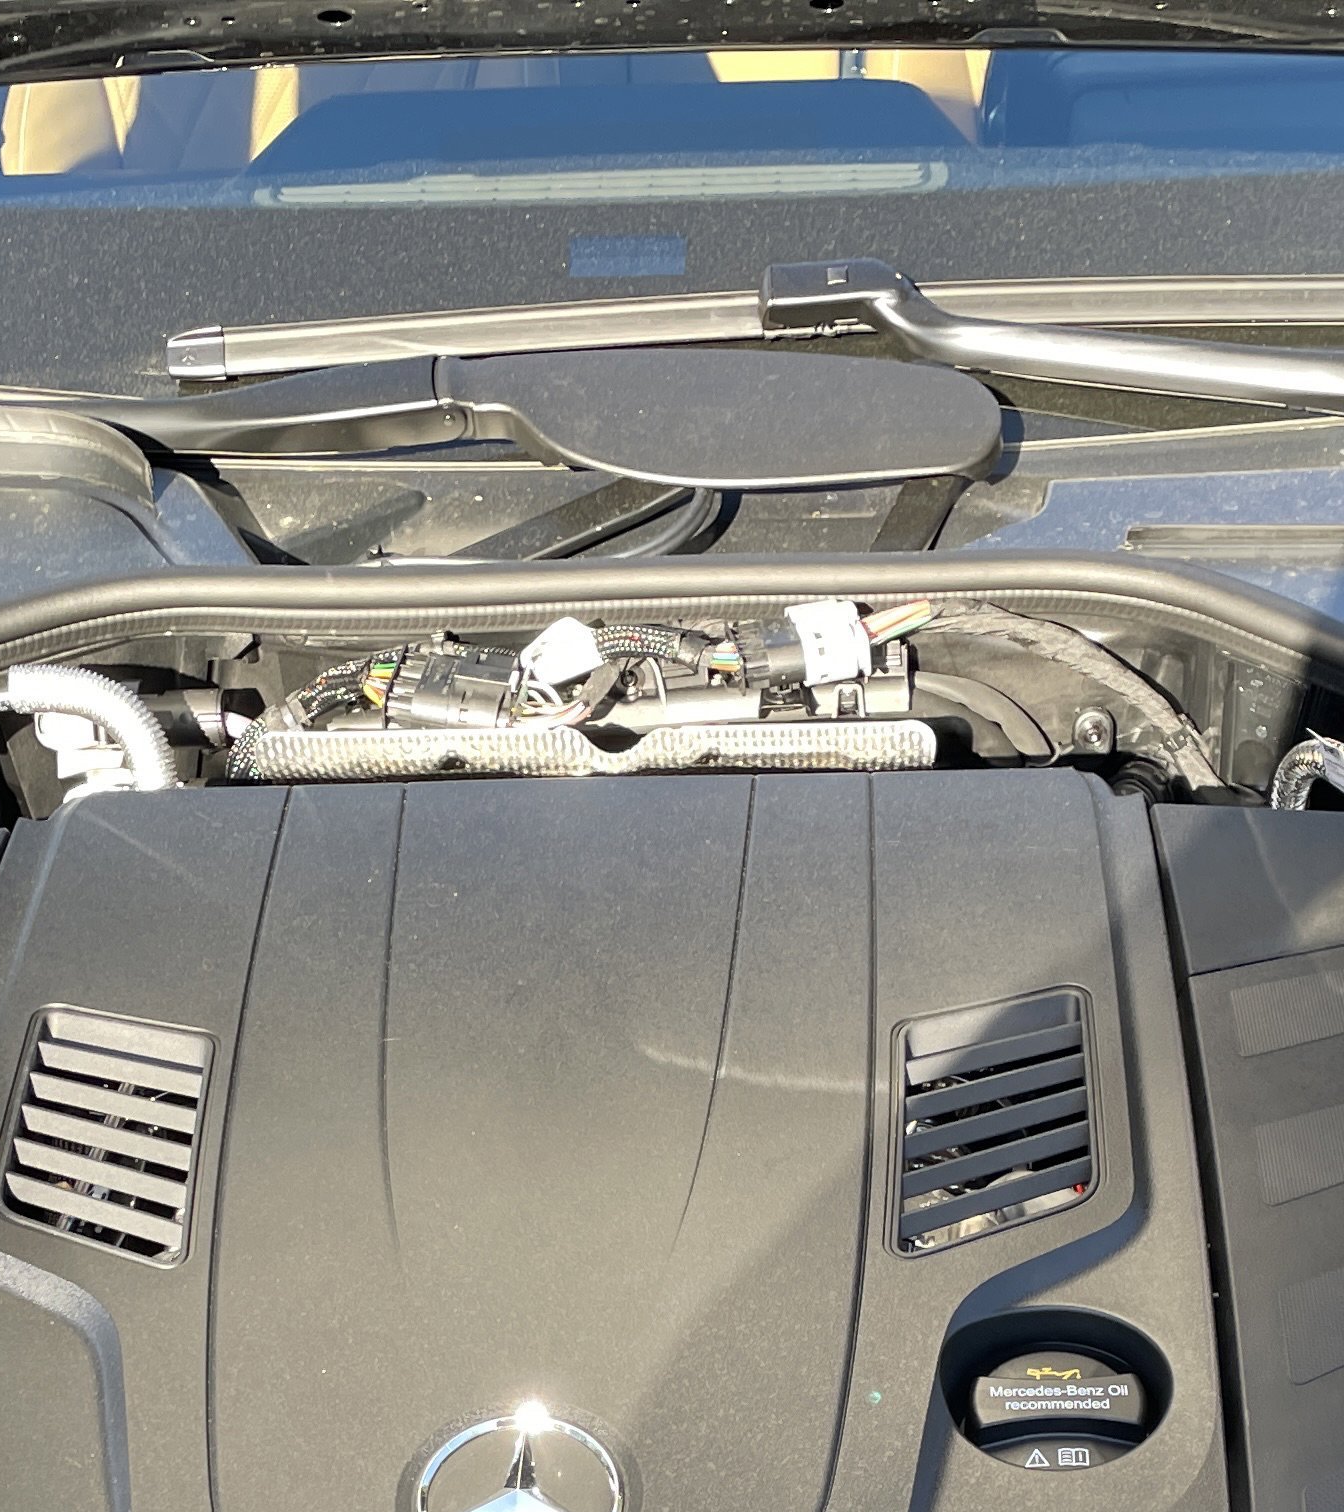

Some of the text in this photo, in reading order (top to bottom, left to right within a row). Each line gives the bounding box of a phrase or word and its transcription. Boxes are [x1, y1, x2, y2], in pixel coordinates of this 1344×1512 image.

[988, 1384, 1129, 1398] Mercedes-Benz Oil
[1004, 1398, 1111, 1410] recommended
